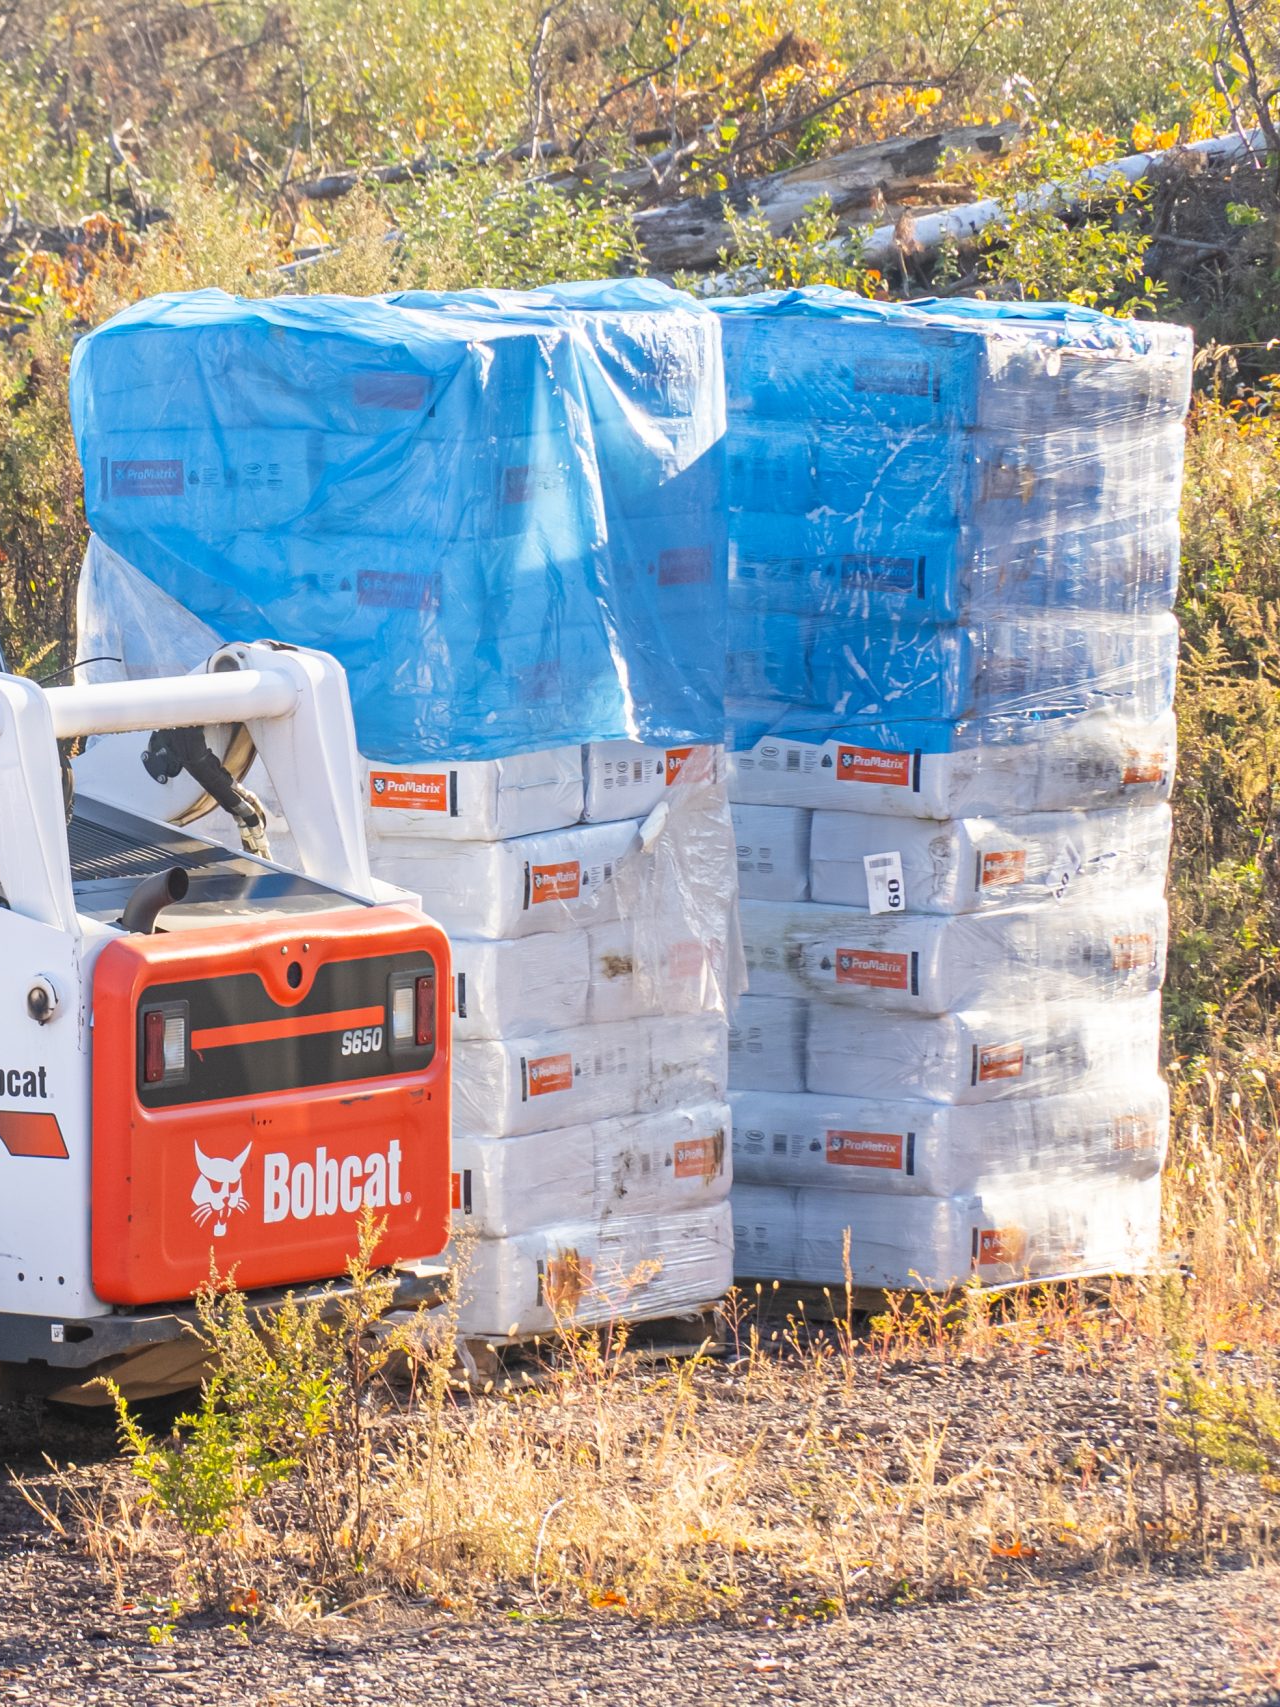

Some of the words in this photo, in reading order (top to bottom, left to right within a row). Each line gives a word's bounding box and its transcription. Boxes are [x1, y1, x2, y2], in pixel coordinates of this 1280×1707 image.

[853, 755, 904, 769] ProMatrix
[387, 780, 440, 794] ProMatrix
[851, 958, 902, 972] ProMatrix
[341, 1026, 383, 1056] S650
[843, 1139, 897, 1153] ProMatrix
